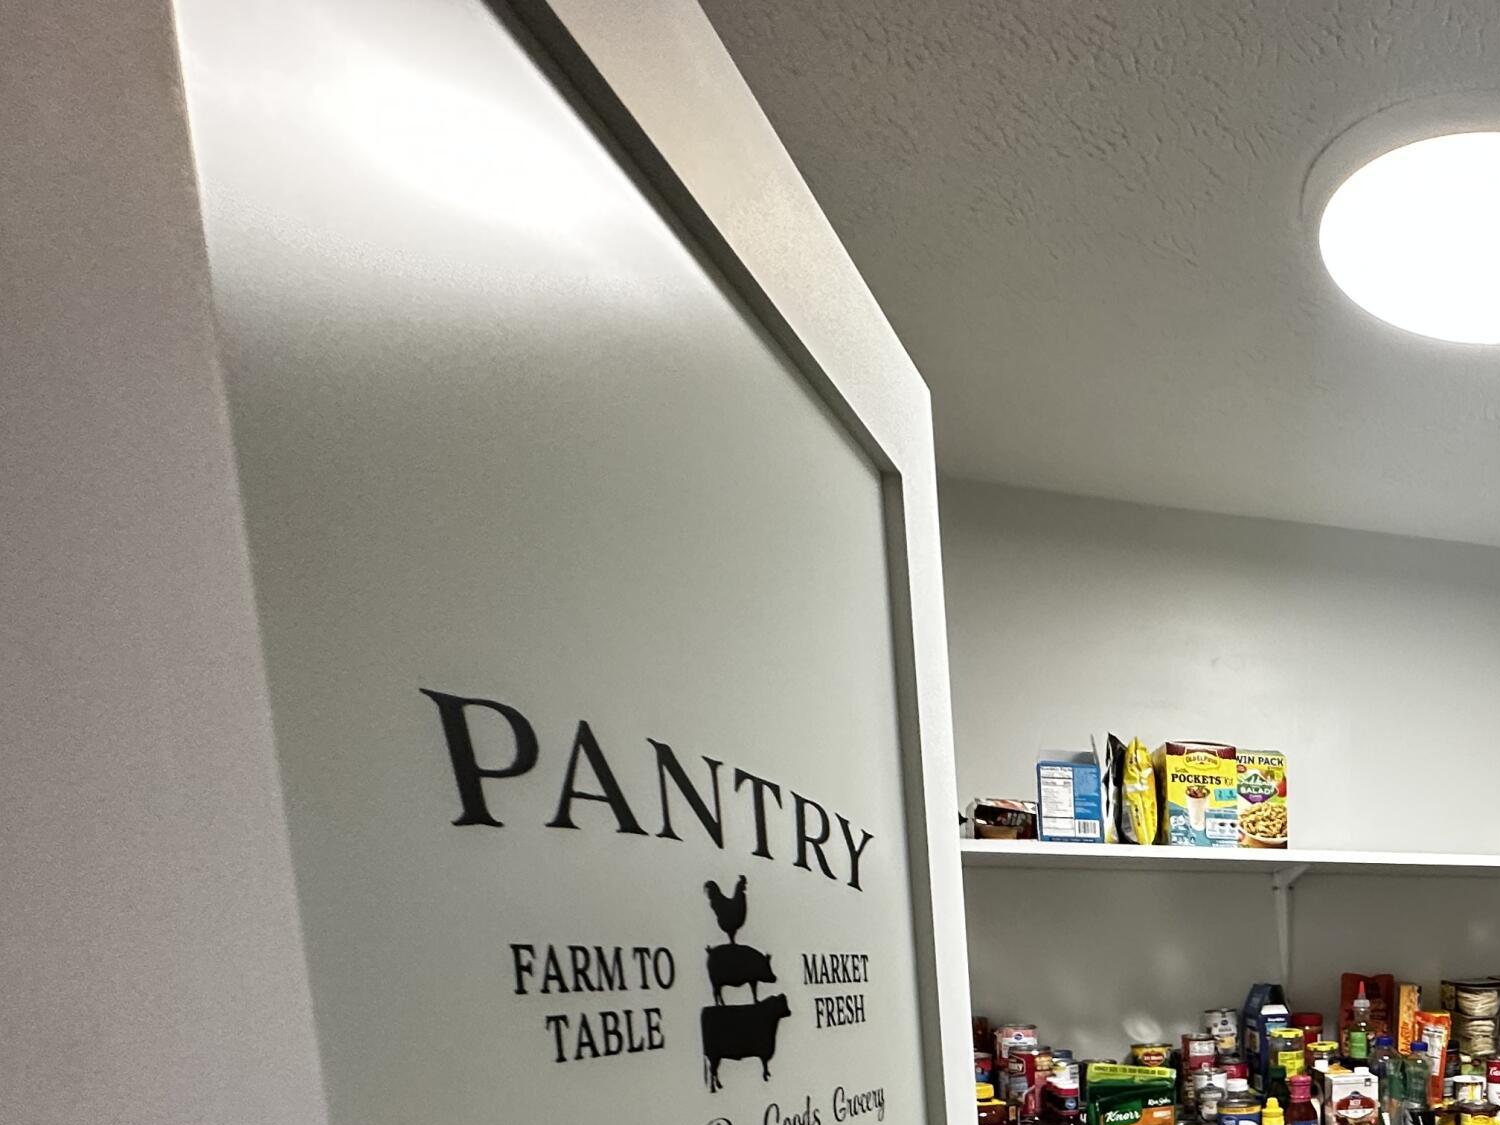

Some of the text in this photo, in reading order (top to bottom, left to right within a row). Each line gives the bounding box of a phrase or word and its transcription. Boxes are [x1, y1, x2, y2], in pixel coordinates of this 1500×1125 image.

[1236, 755, 1284, 767] WIN PACK
[419, 688, 873, 892] PANTRY
[1171, 773, 1222, 785] POCKETS
[510, 944, 676, 994] FARM TO
[802, 954, 869, 985] MARKET
[814, 994, 866, 1029] FRESH
[546, 1007, 665, 1063] TABLE
[832, 1086, 886, 1122] Grocery
[1105, 1110, 1141, 1123] Knorr
